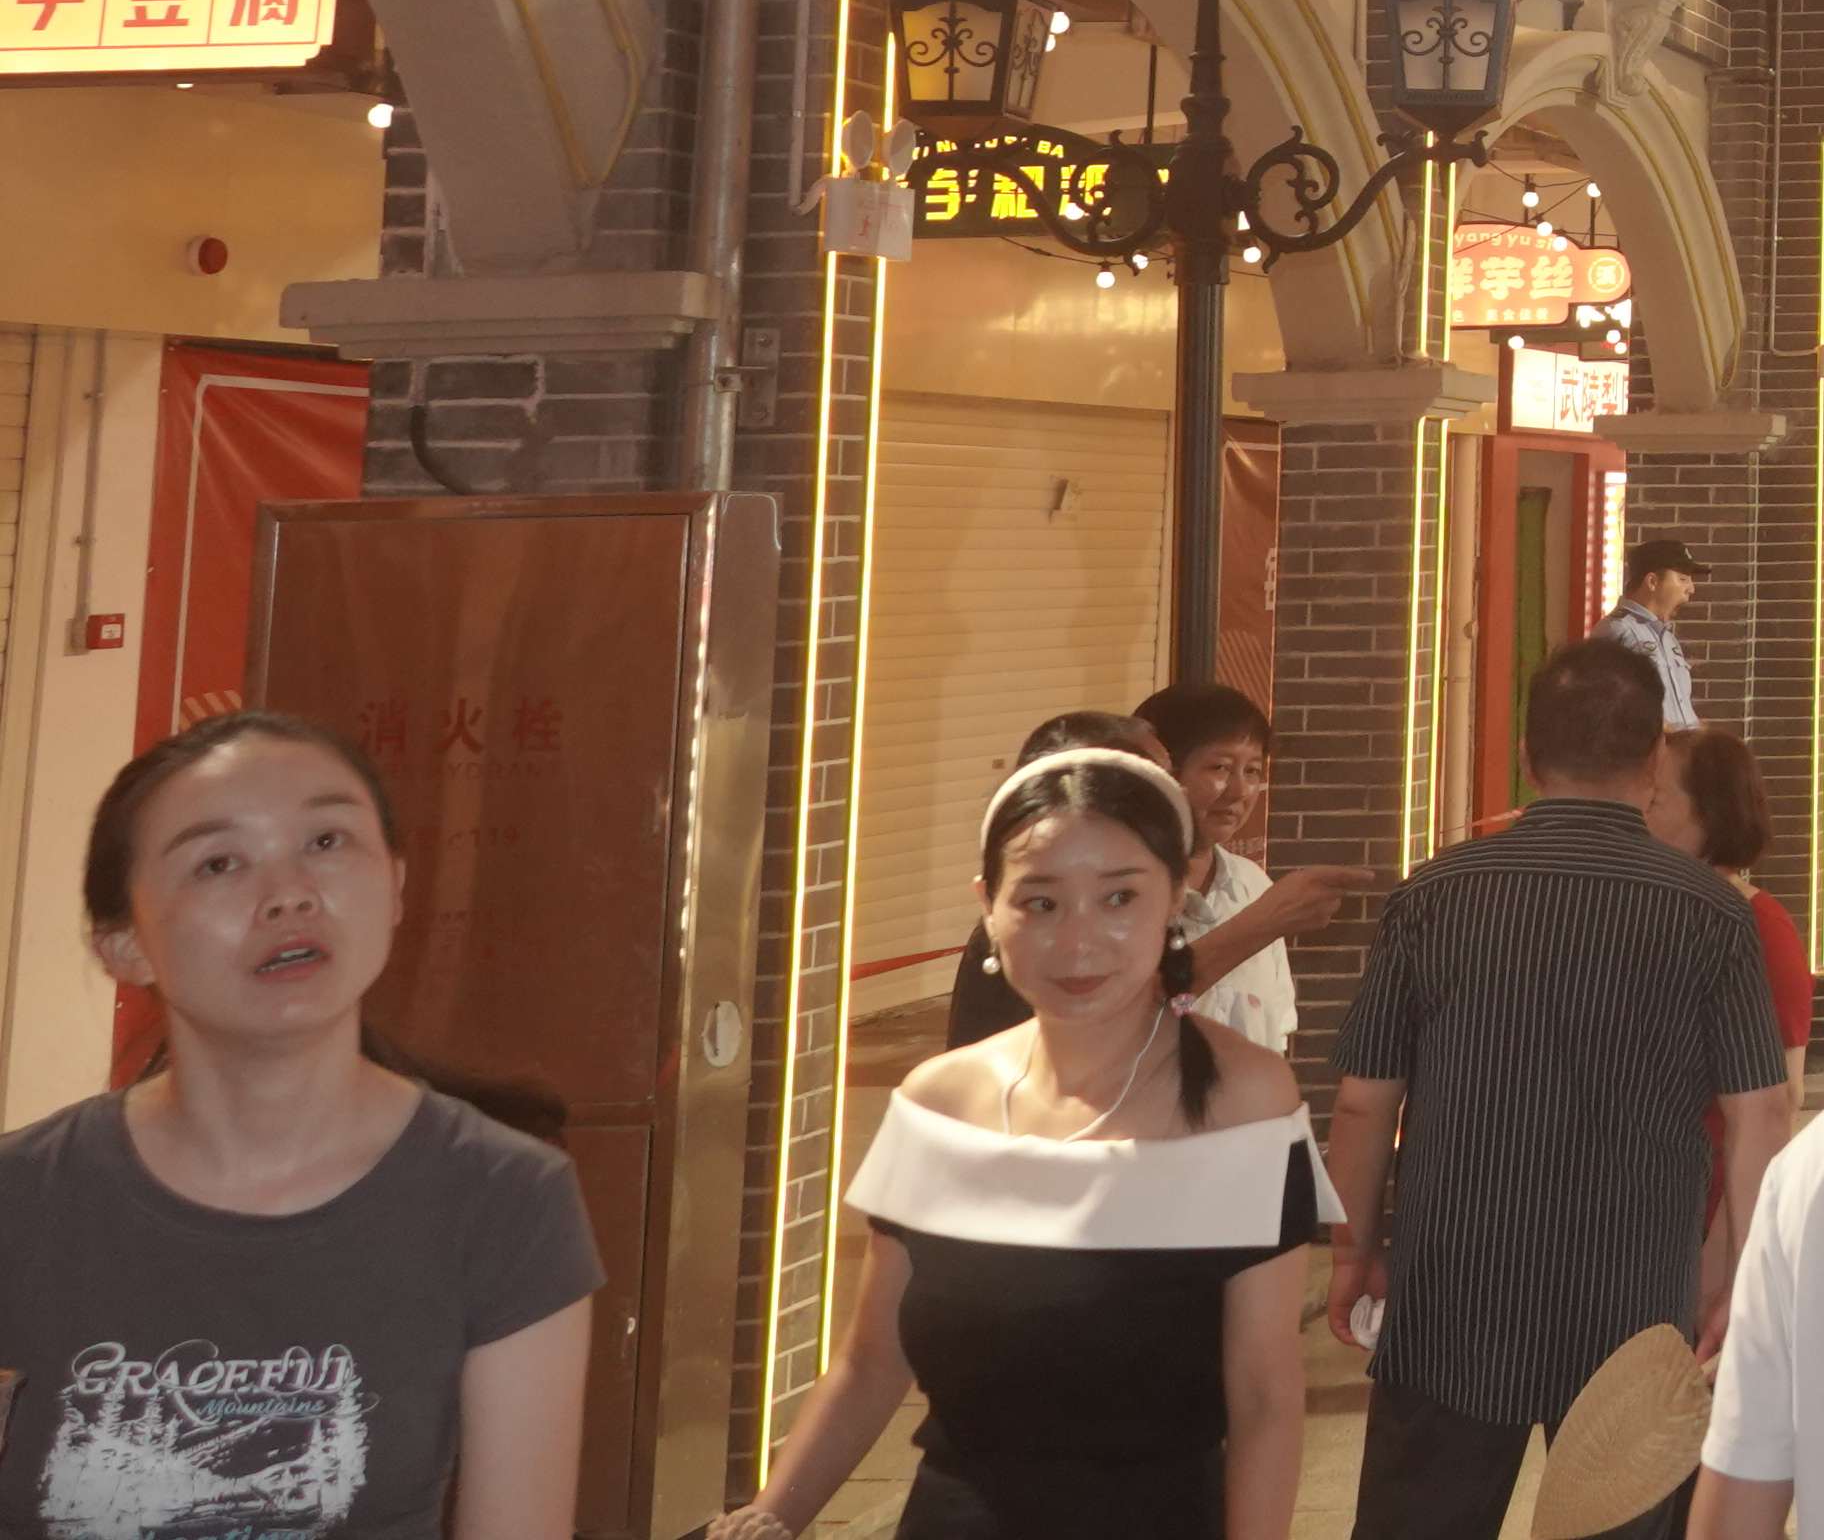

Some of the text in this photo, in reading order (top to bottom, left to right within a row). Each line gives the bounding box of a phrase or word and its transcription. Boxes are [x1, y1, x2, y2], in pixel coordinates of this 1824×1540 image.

[1507, 233, 1532, 248] yu
[357, 696, 564, 755] 消火栓
